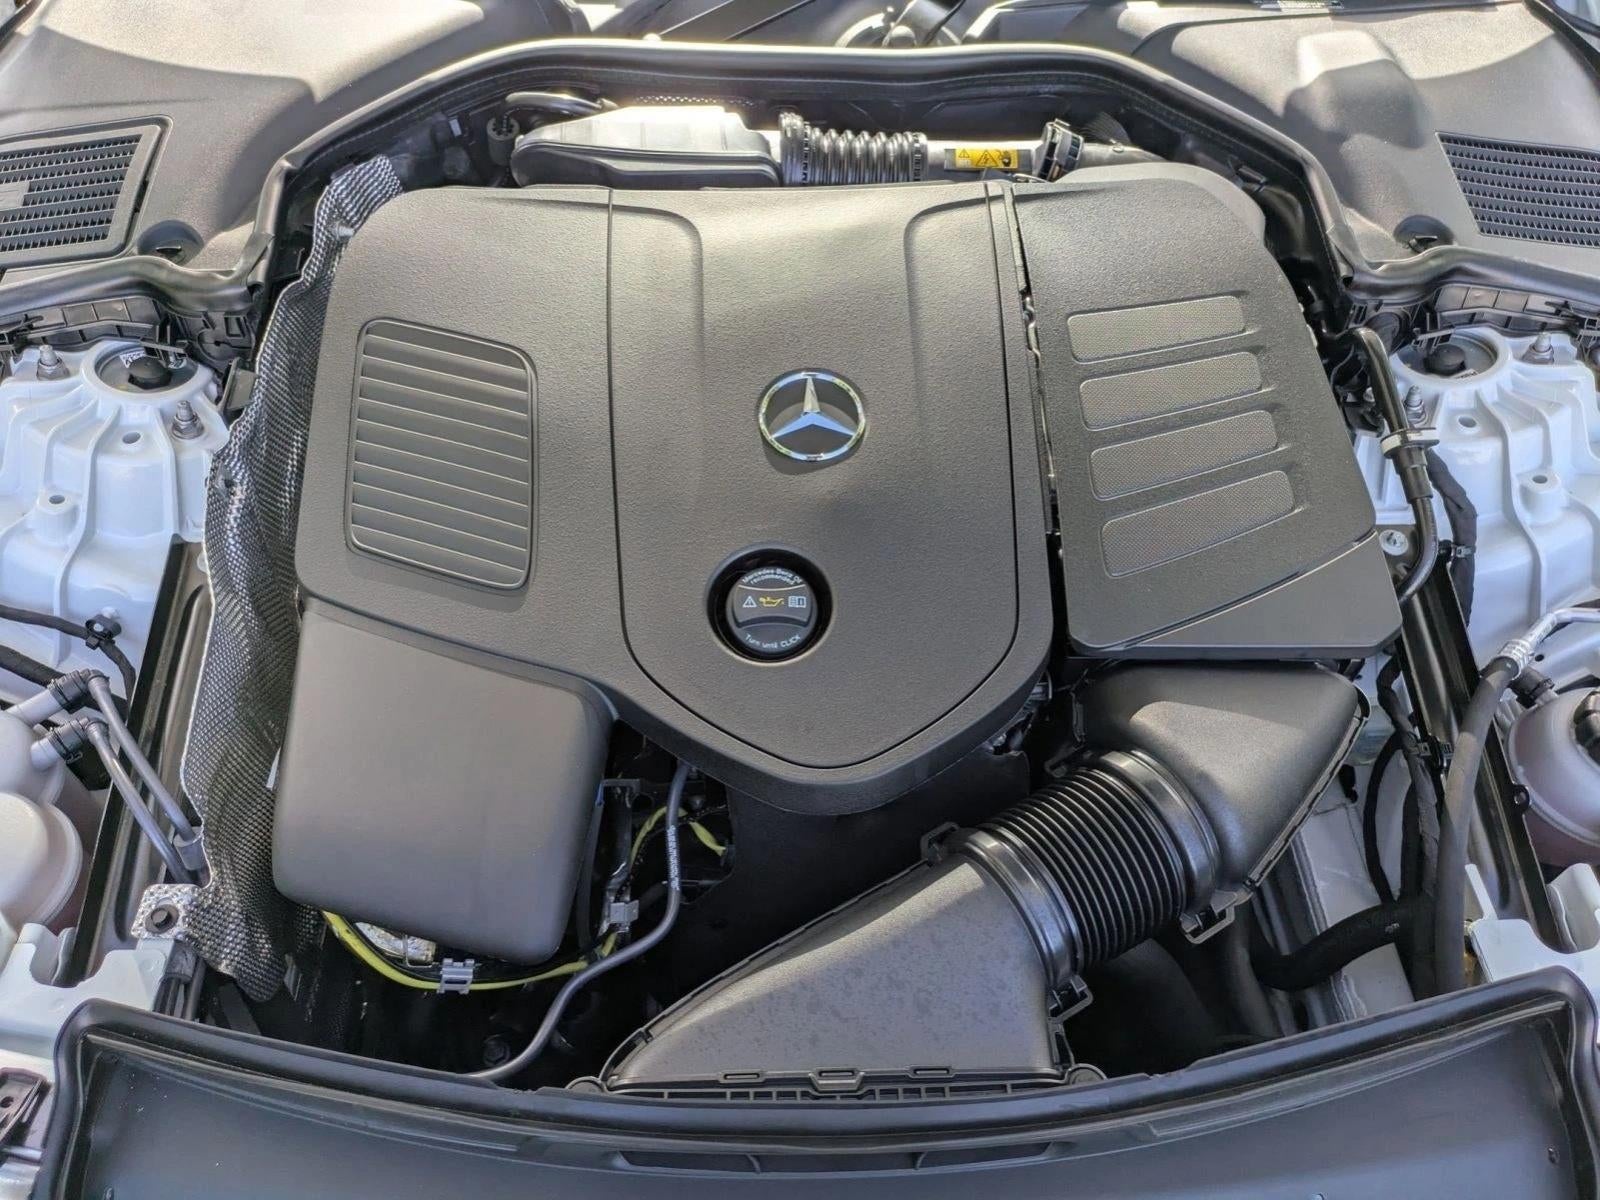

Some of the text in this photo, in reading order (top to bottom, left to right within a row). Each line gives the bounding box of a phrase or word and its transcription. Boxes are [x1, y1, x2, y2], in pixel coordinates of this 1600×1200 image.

[750, 574, 795, 585] recommended
[745, 633, 801, 649] Turn until CLICK
